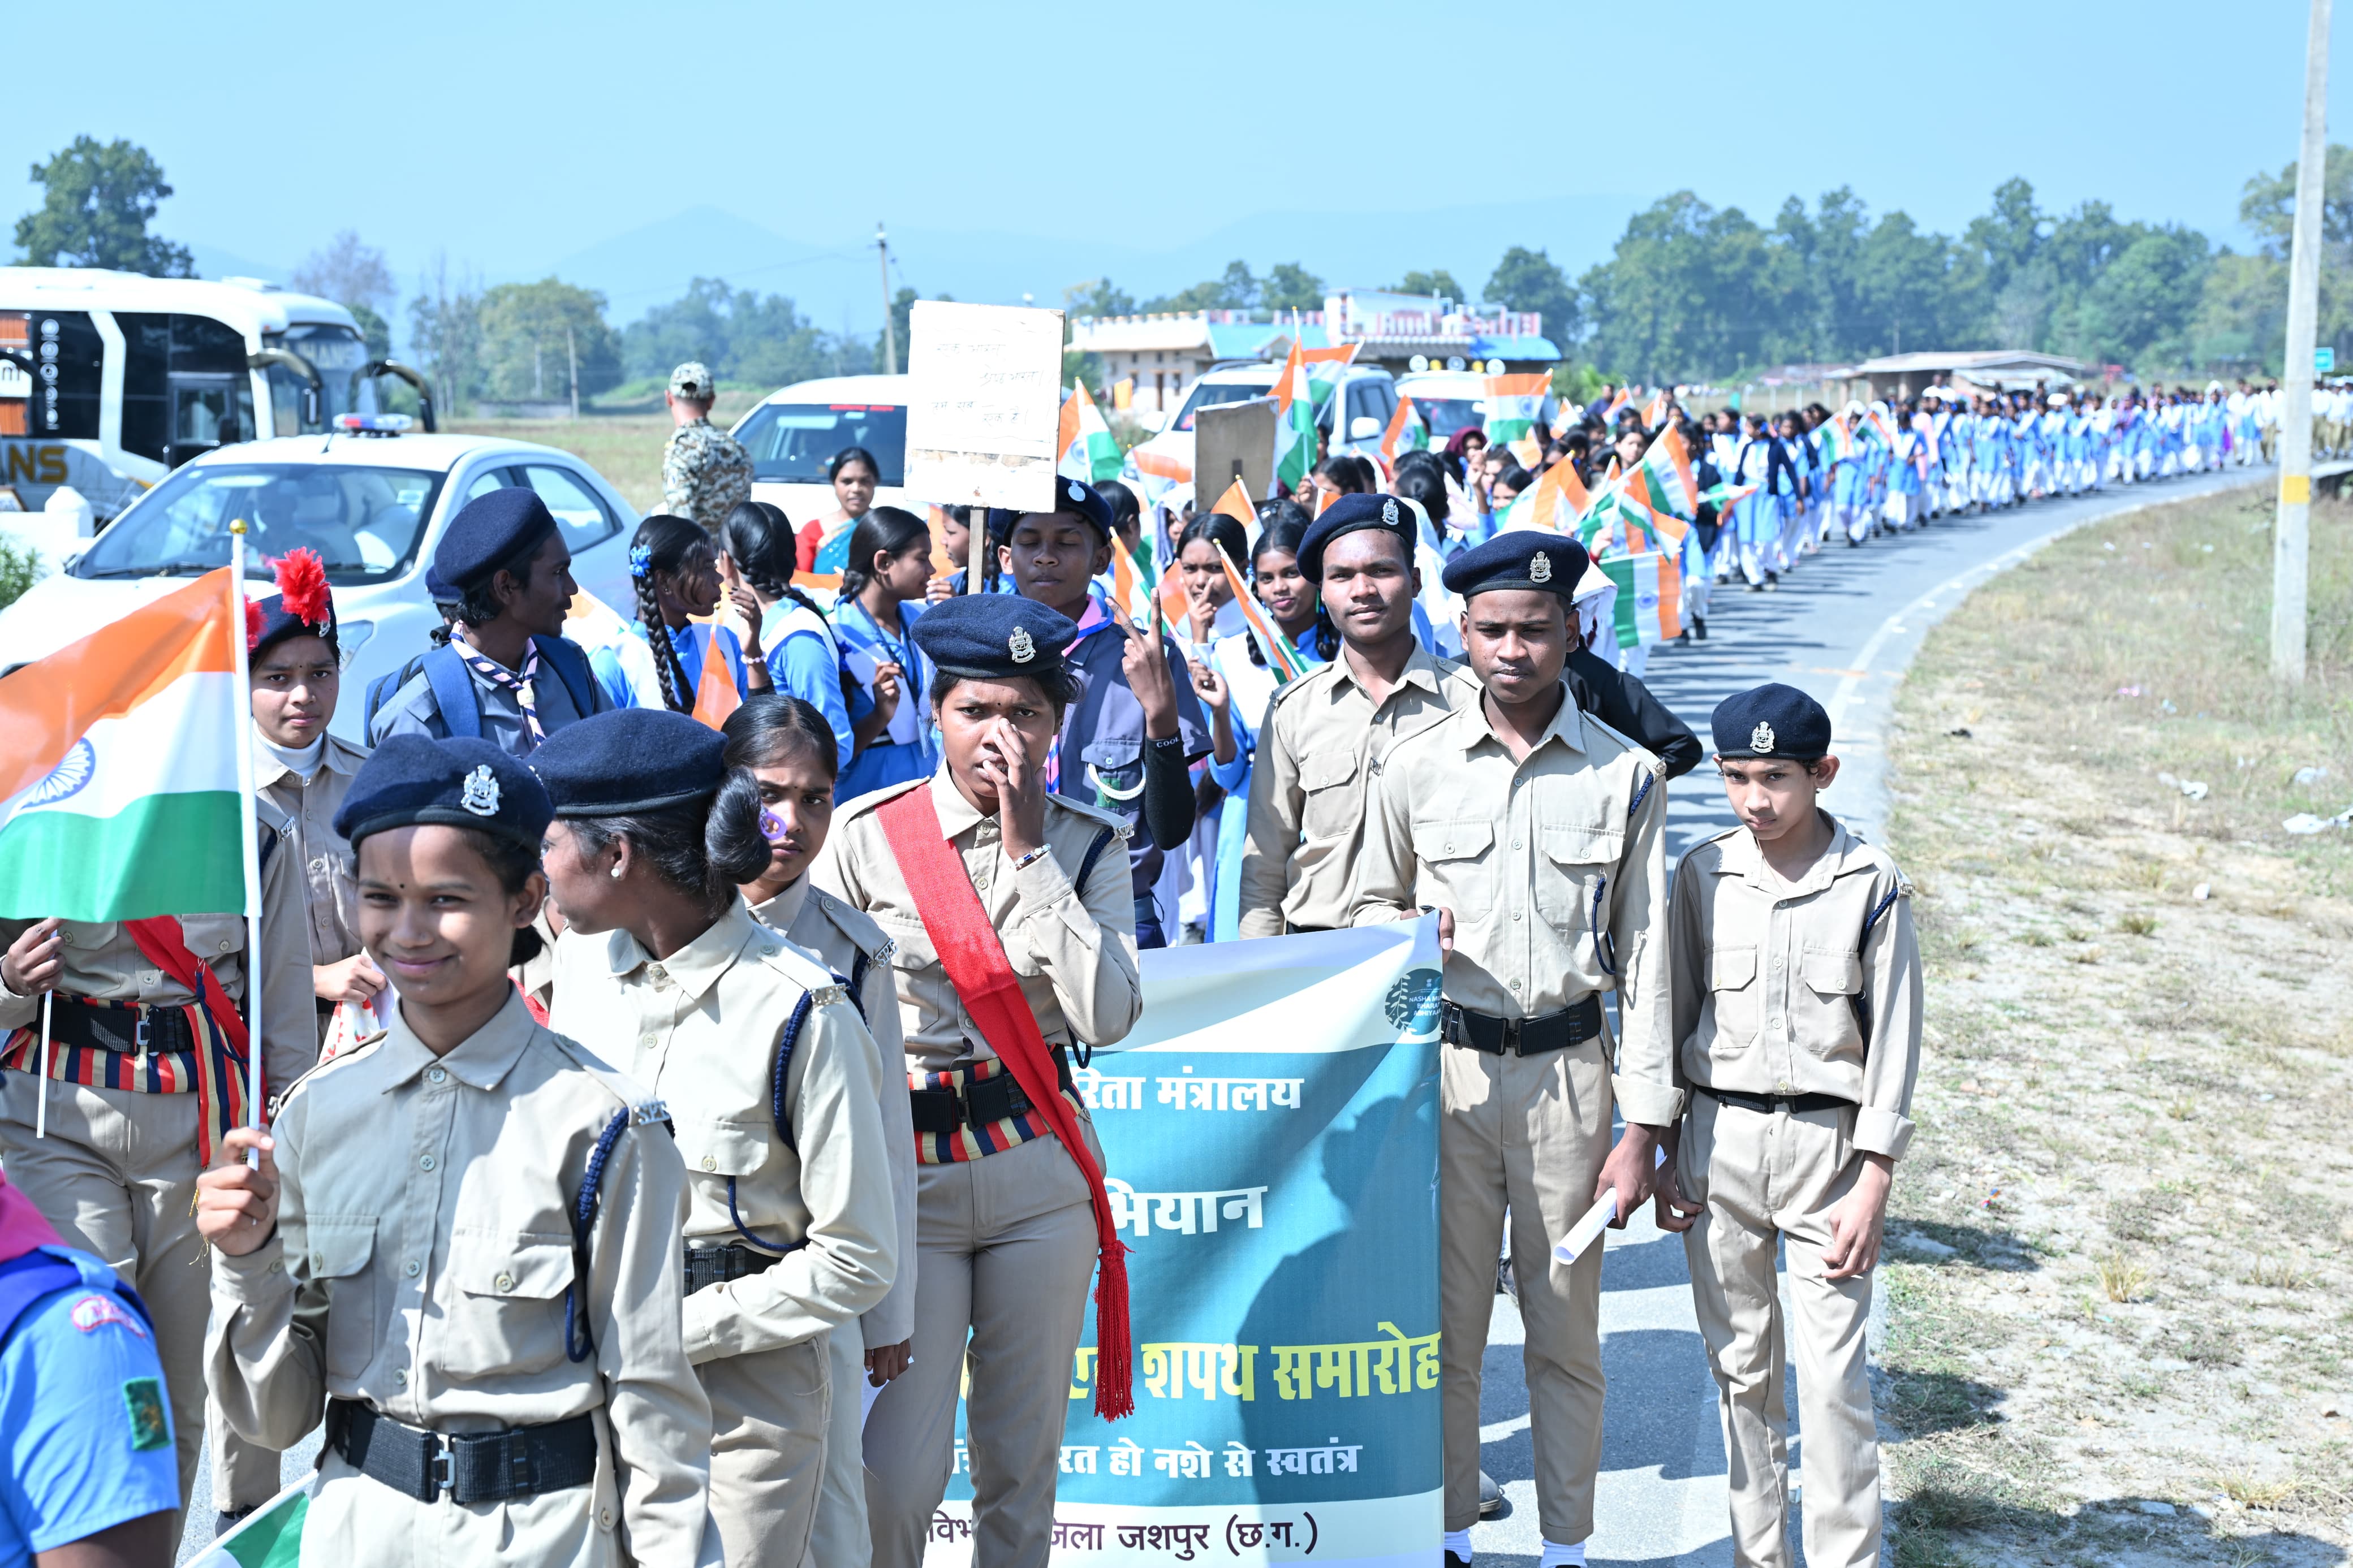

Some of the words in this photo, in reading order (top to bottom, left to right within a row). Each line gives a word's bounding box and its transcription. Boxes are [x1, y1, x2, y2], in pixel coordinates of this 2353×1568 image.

[1156, 737, 1179, 748] COOL
[874, 938, 899, 967] SPC
[1156, 1066, 1304, 1111] मंत्रालय
[1141, 1342, 1259, 1401] शपथ
[1270, 1321, 1441, 1401] समारोह
[1108, 1437, 1145, 1476] हो
[1153, 1441, 1214, 1478] नशे
[1222, 1441, 1256, 1477] से
[1265, 1437, 1363, 1476] स्वतंत्र
[1117, 1524, 1210, 1561] जशपुर
[1226, 1511, 1318, 1557] (छ.ग.)
